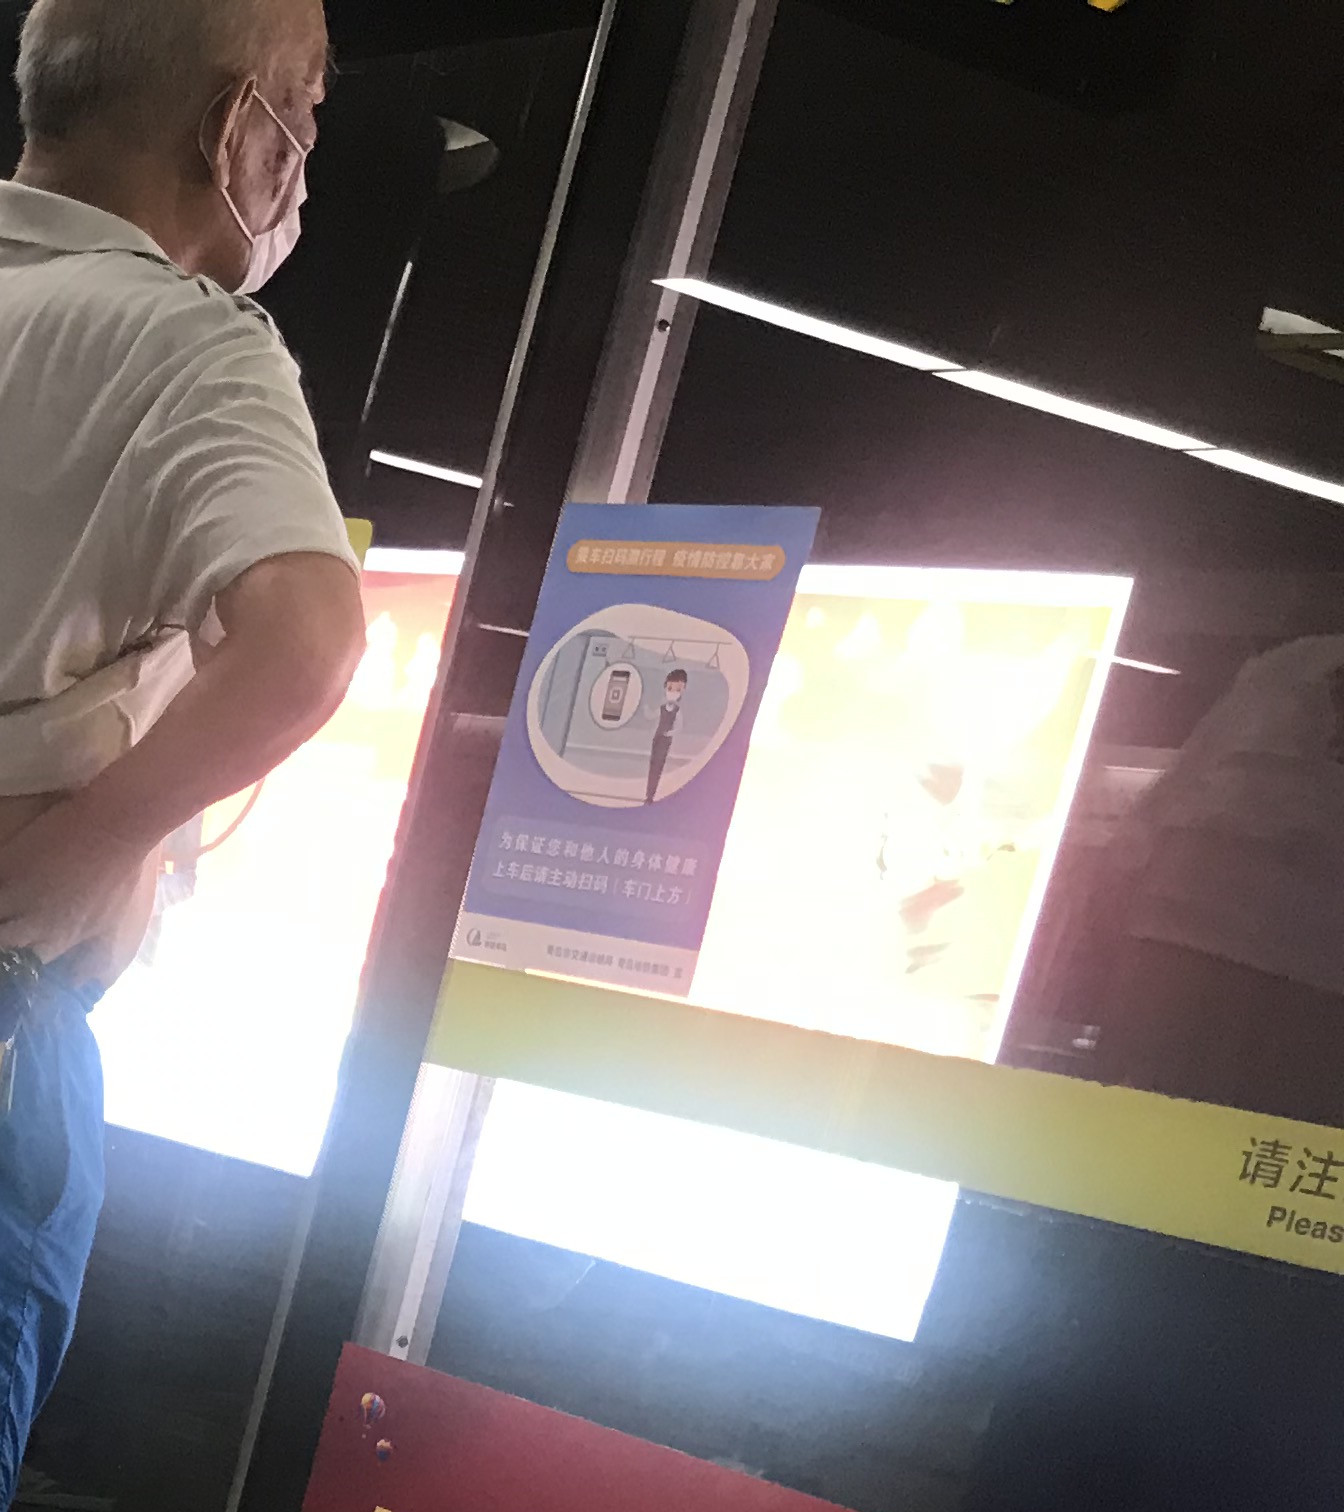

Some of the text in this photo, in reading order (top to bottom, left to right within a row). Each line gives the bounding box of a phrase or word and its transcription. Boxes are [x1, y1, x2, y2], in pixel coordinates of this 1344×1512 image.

[498, 831, 698, 876] 为保证您和他人的身体健康
[1239, 1136, 1344, 1200] 请注
[1266, 1205, 1344, 1244] Pleas
